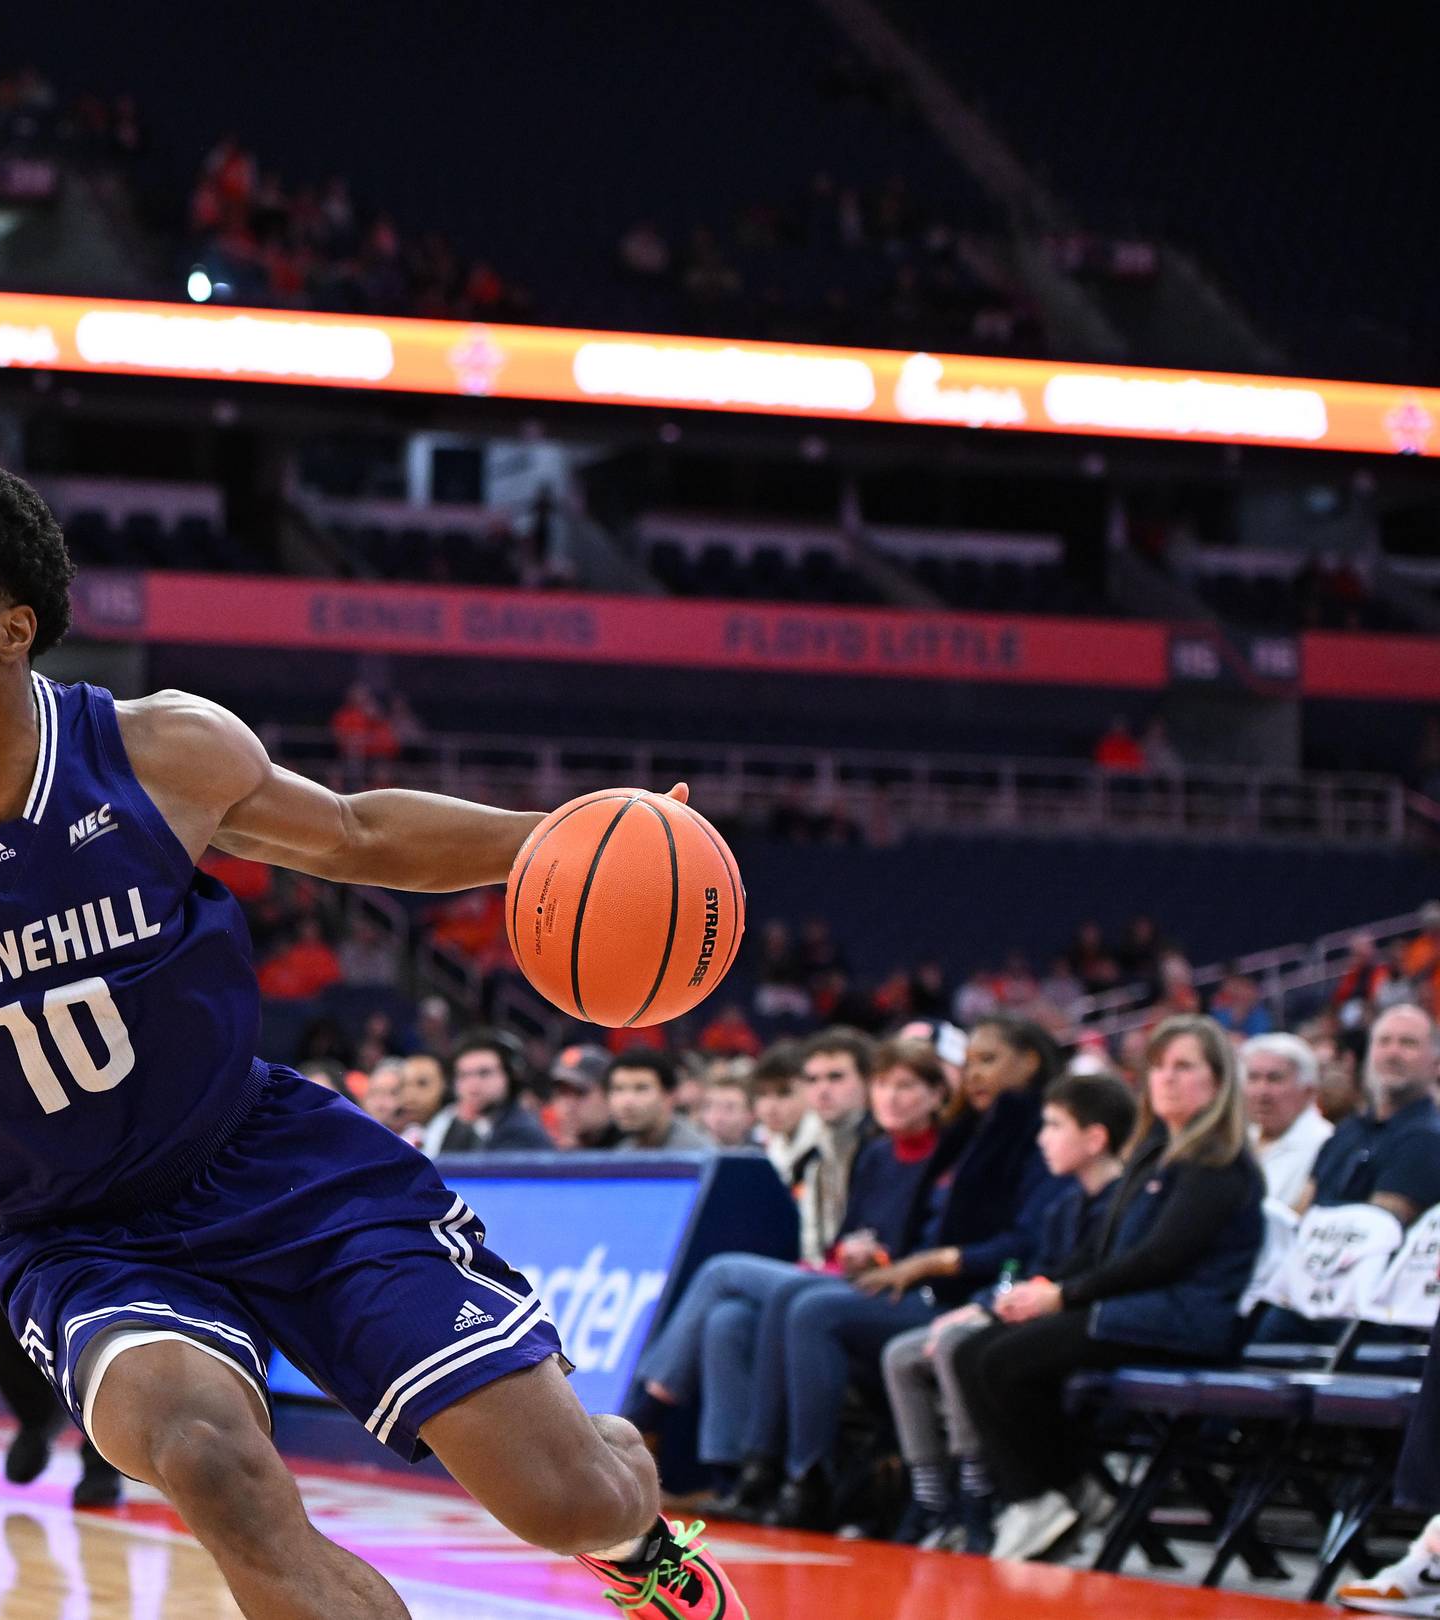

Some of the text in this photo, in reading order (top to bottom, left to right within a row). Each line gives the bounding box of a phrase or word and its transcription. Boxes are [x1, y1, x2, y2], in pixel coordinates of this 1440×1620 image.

[308, 592, 598, 649] ERNIE DAVIS
[724, 612, 1021, 670] FLOYD LITTLE
[68, 803, 111, 847] NEC
[687, 887, 719, 988] SYRACUSE
[453, 1312, 495, 1333] adidas
[520, 1243, 668, 1372] ster
